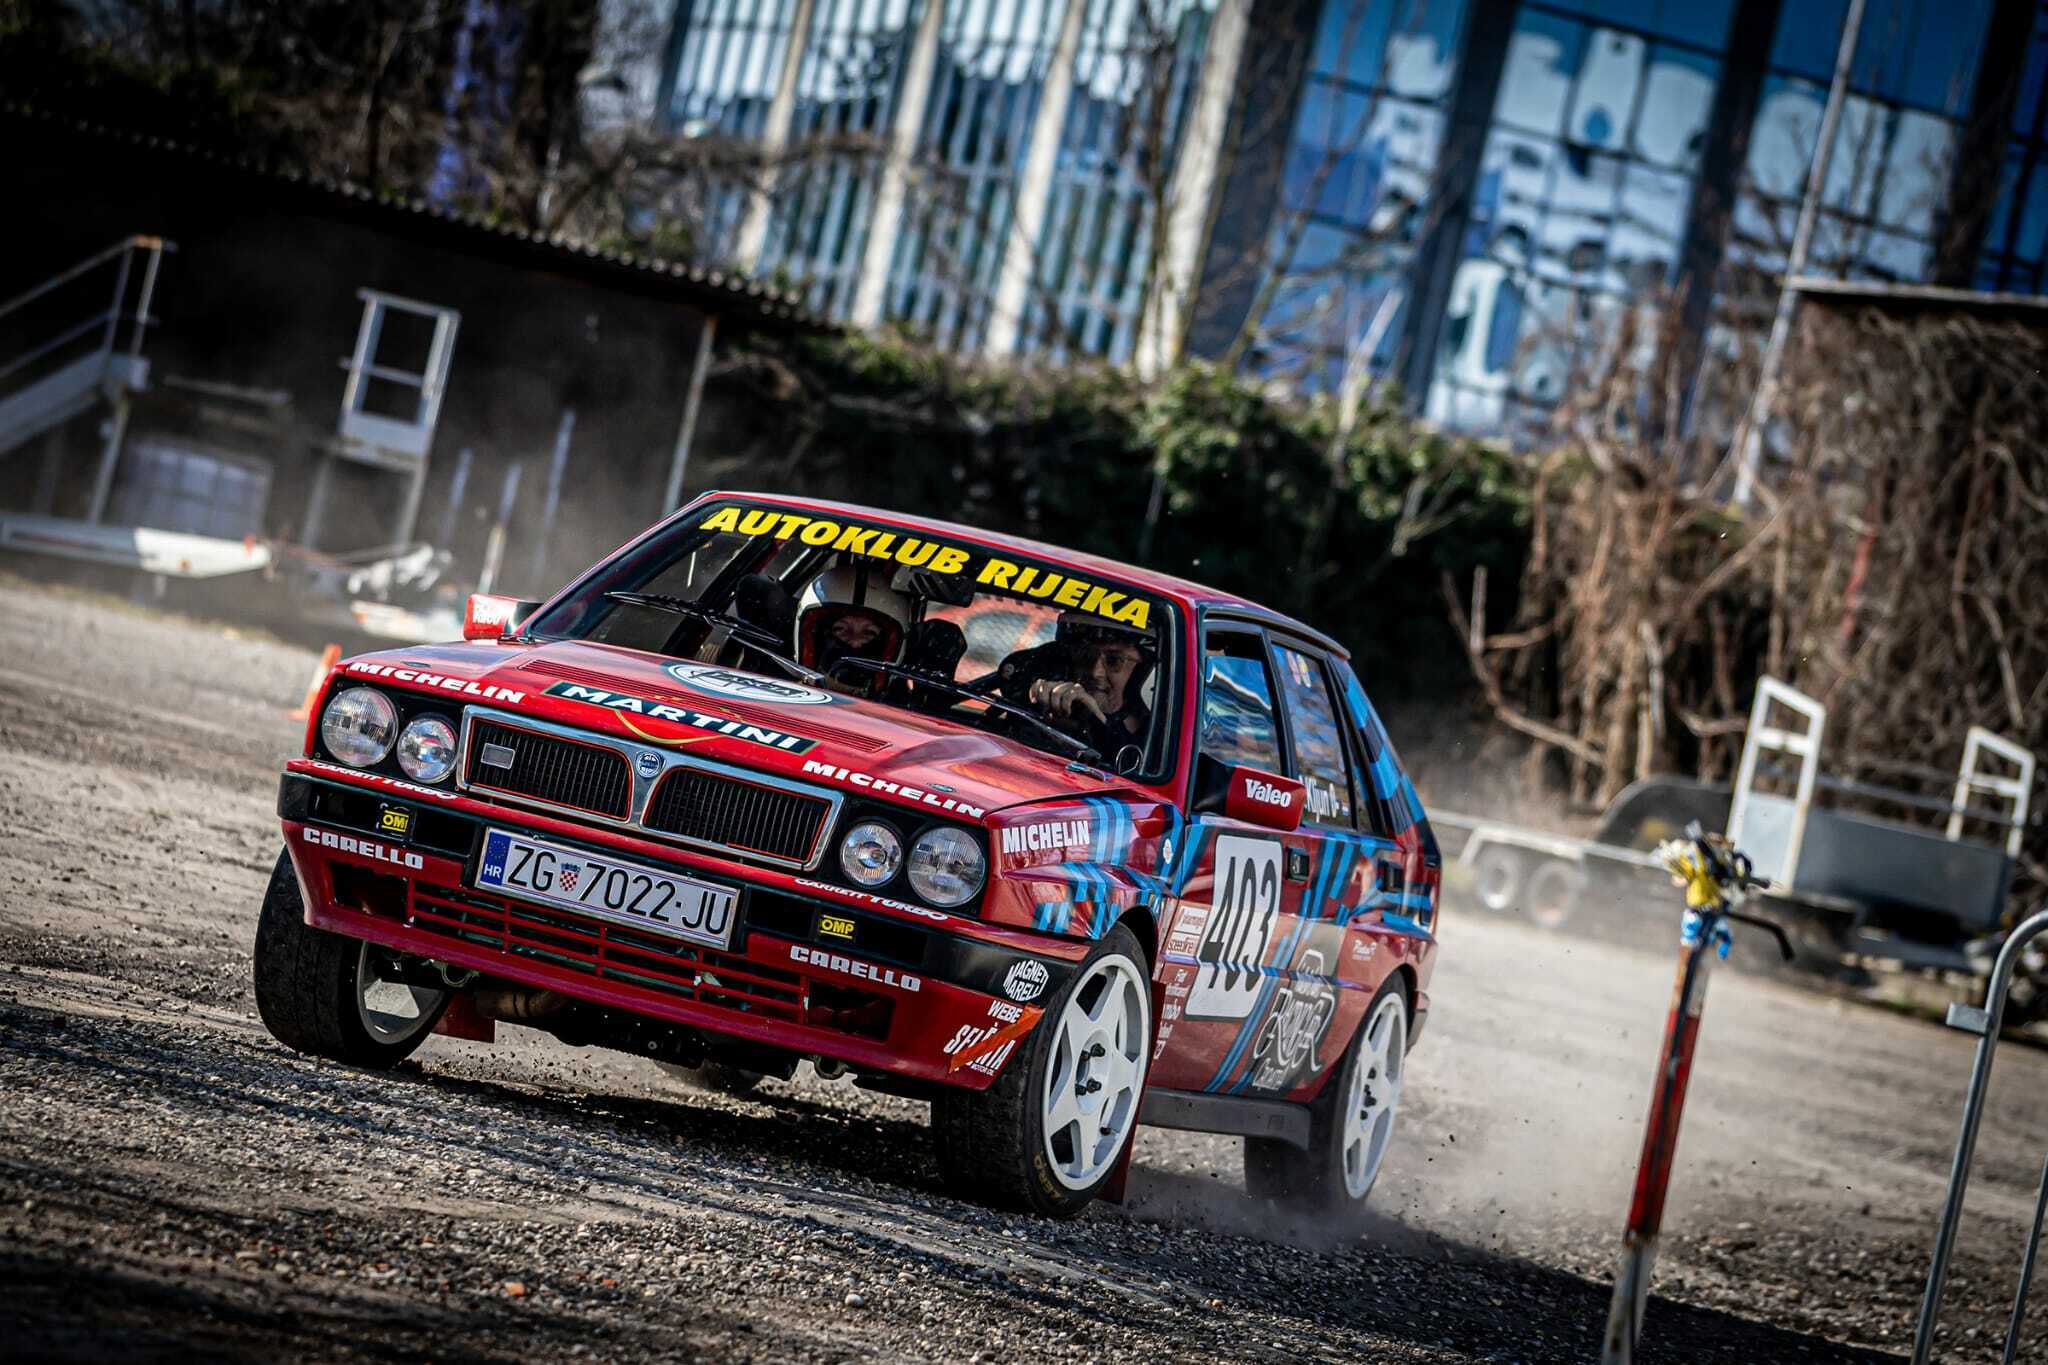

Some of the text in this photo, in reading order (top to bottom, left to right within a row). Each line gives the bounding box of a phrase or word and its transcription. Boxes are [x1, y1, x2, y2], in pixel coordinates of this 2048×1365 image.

[699, 507, 1150, 629] AUTOKLUB RIJEKA
[350, 662, 526, 704] MICHELIN
[562, 686, 801, 749] MARTINI
[802, 759, 985, 819] MICHELIN
[1245, 778, 1292, 808] Valeo
[303, 827, 424, 870] CARELLO
[1002, 820, 1090, 853] MICHELIN
[483, 863, 502, 880] HR
[507, 845, 557, 892] ZG
[821, 918, 855, 935] OMP
[870, 894, 949, 921] TURBO
[1199, 856, 1276, 992] 403
[790, 945, 921, 992] CARELLO
